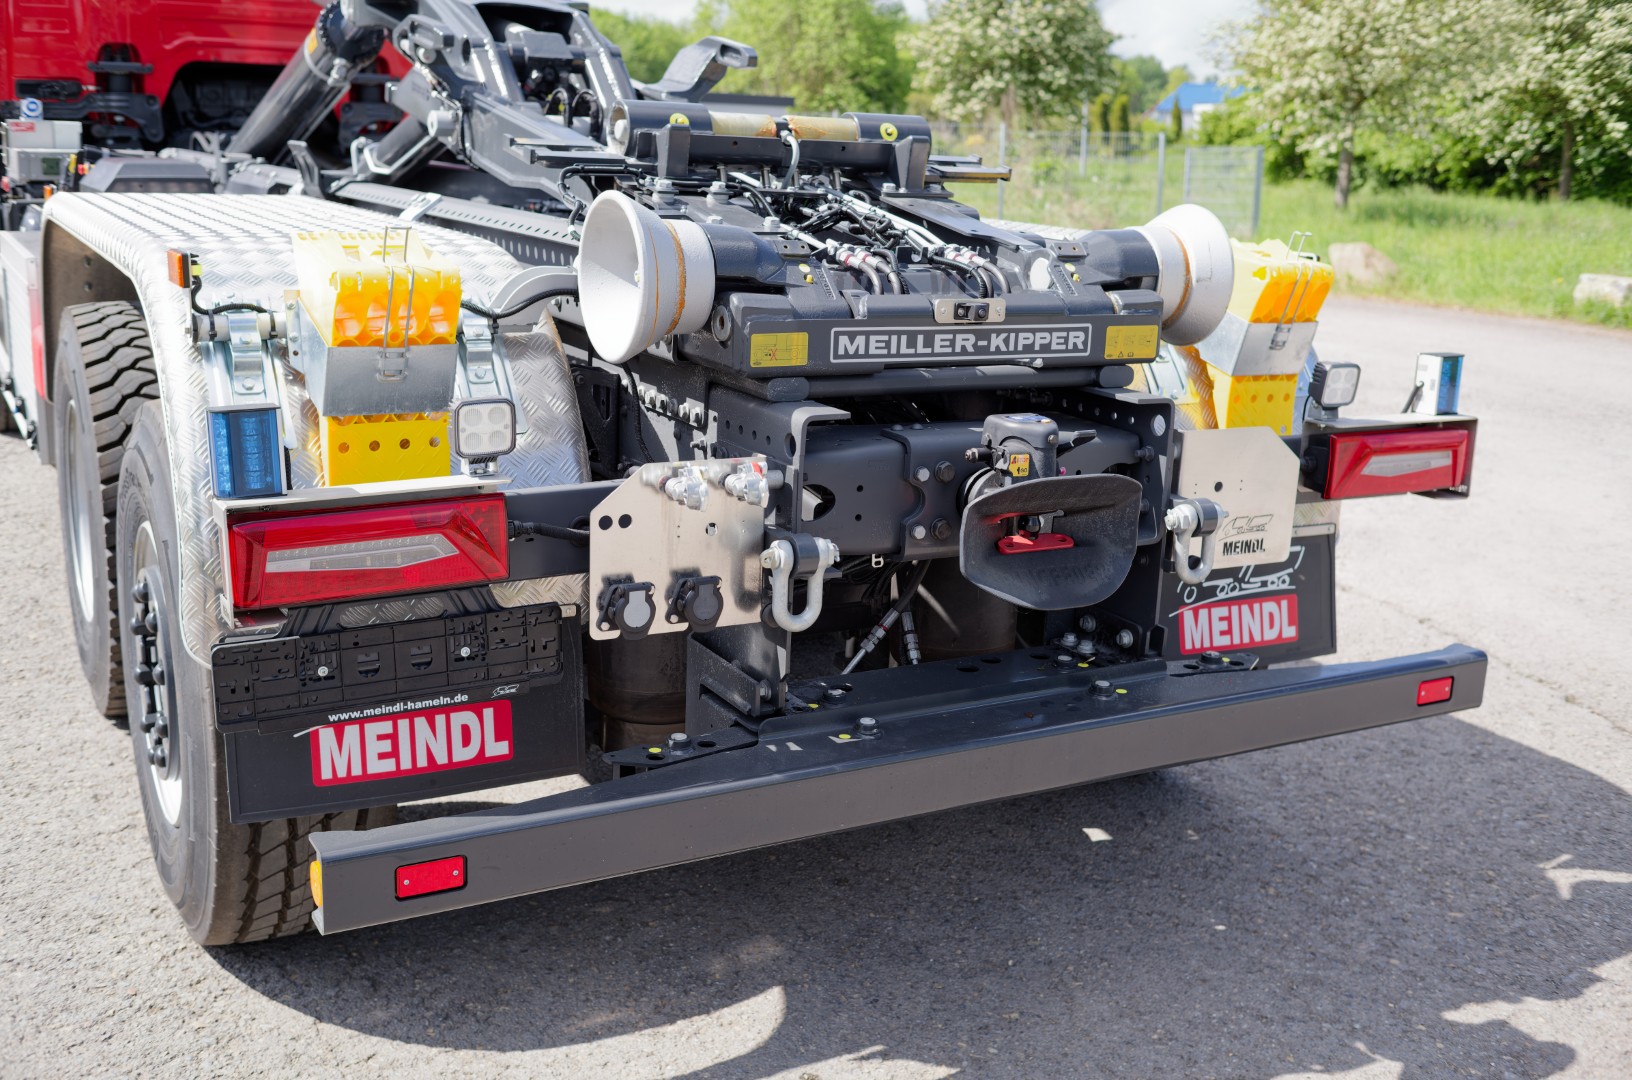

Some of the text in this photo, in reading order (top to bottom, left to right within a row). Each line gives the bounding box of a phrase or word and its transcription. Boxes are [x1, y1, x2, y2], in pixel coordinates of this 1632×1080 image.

[837, 330, 1085, 355] MEILLER-KIPPER
[1223, 537, 1266, 556] MEINDL
[1183, 599, 1297, 650] MEINDL
[327, 692, 469, 722] www.meindl-hameln.de
[317, 707, 510, 781] MEINDL
